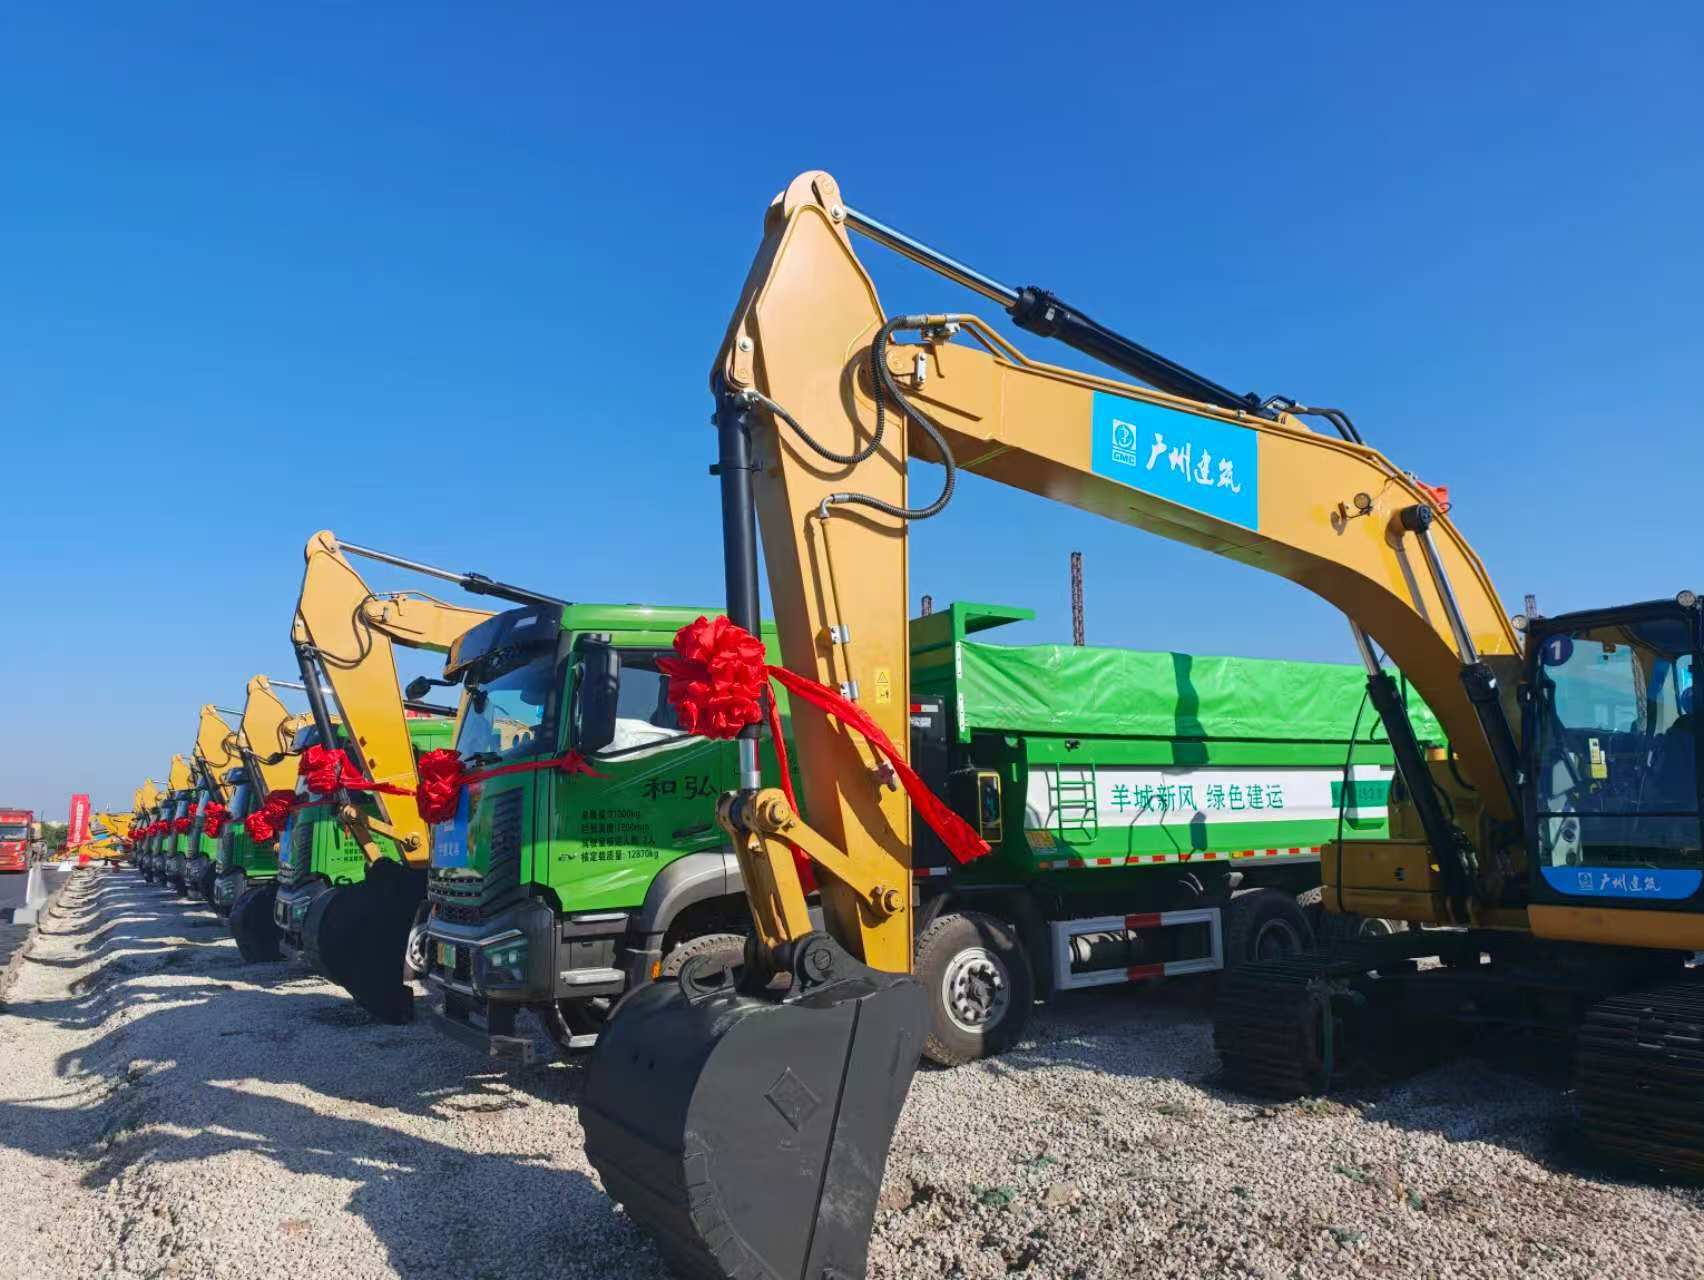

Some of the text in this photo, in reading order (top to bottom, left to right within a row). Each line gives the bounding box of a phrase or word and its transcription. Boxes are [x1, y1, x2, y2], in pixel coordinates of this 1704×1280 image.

[1145, 432, 1241, 493] 广州建筑
[1550, 640, 1561, 660] 1
[1111, 783, 1284, 812] 羊城新风 绿色建运
[1600, 873, 1661, 892] 广州建筑
